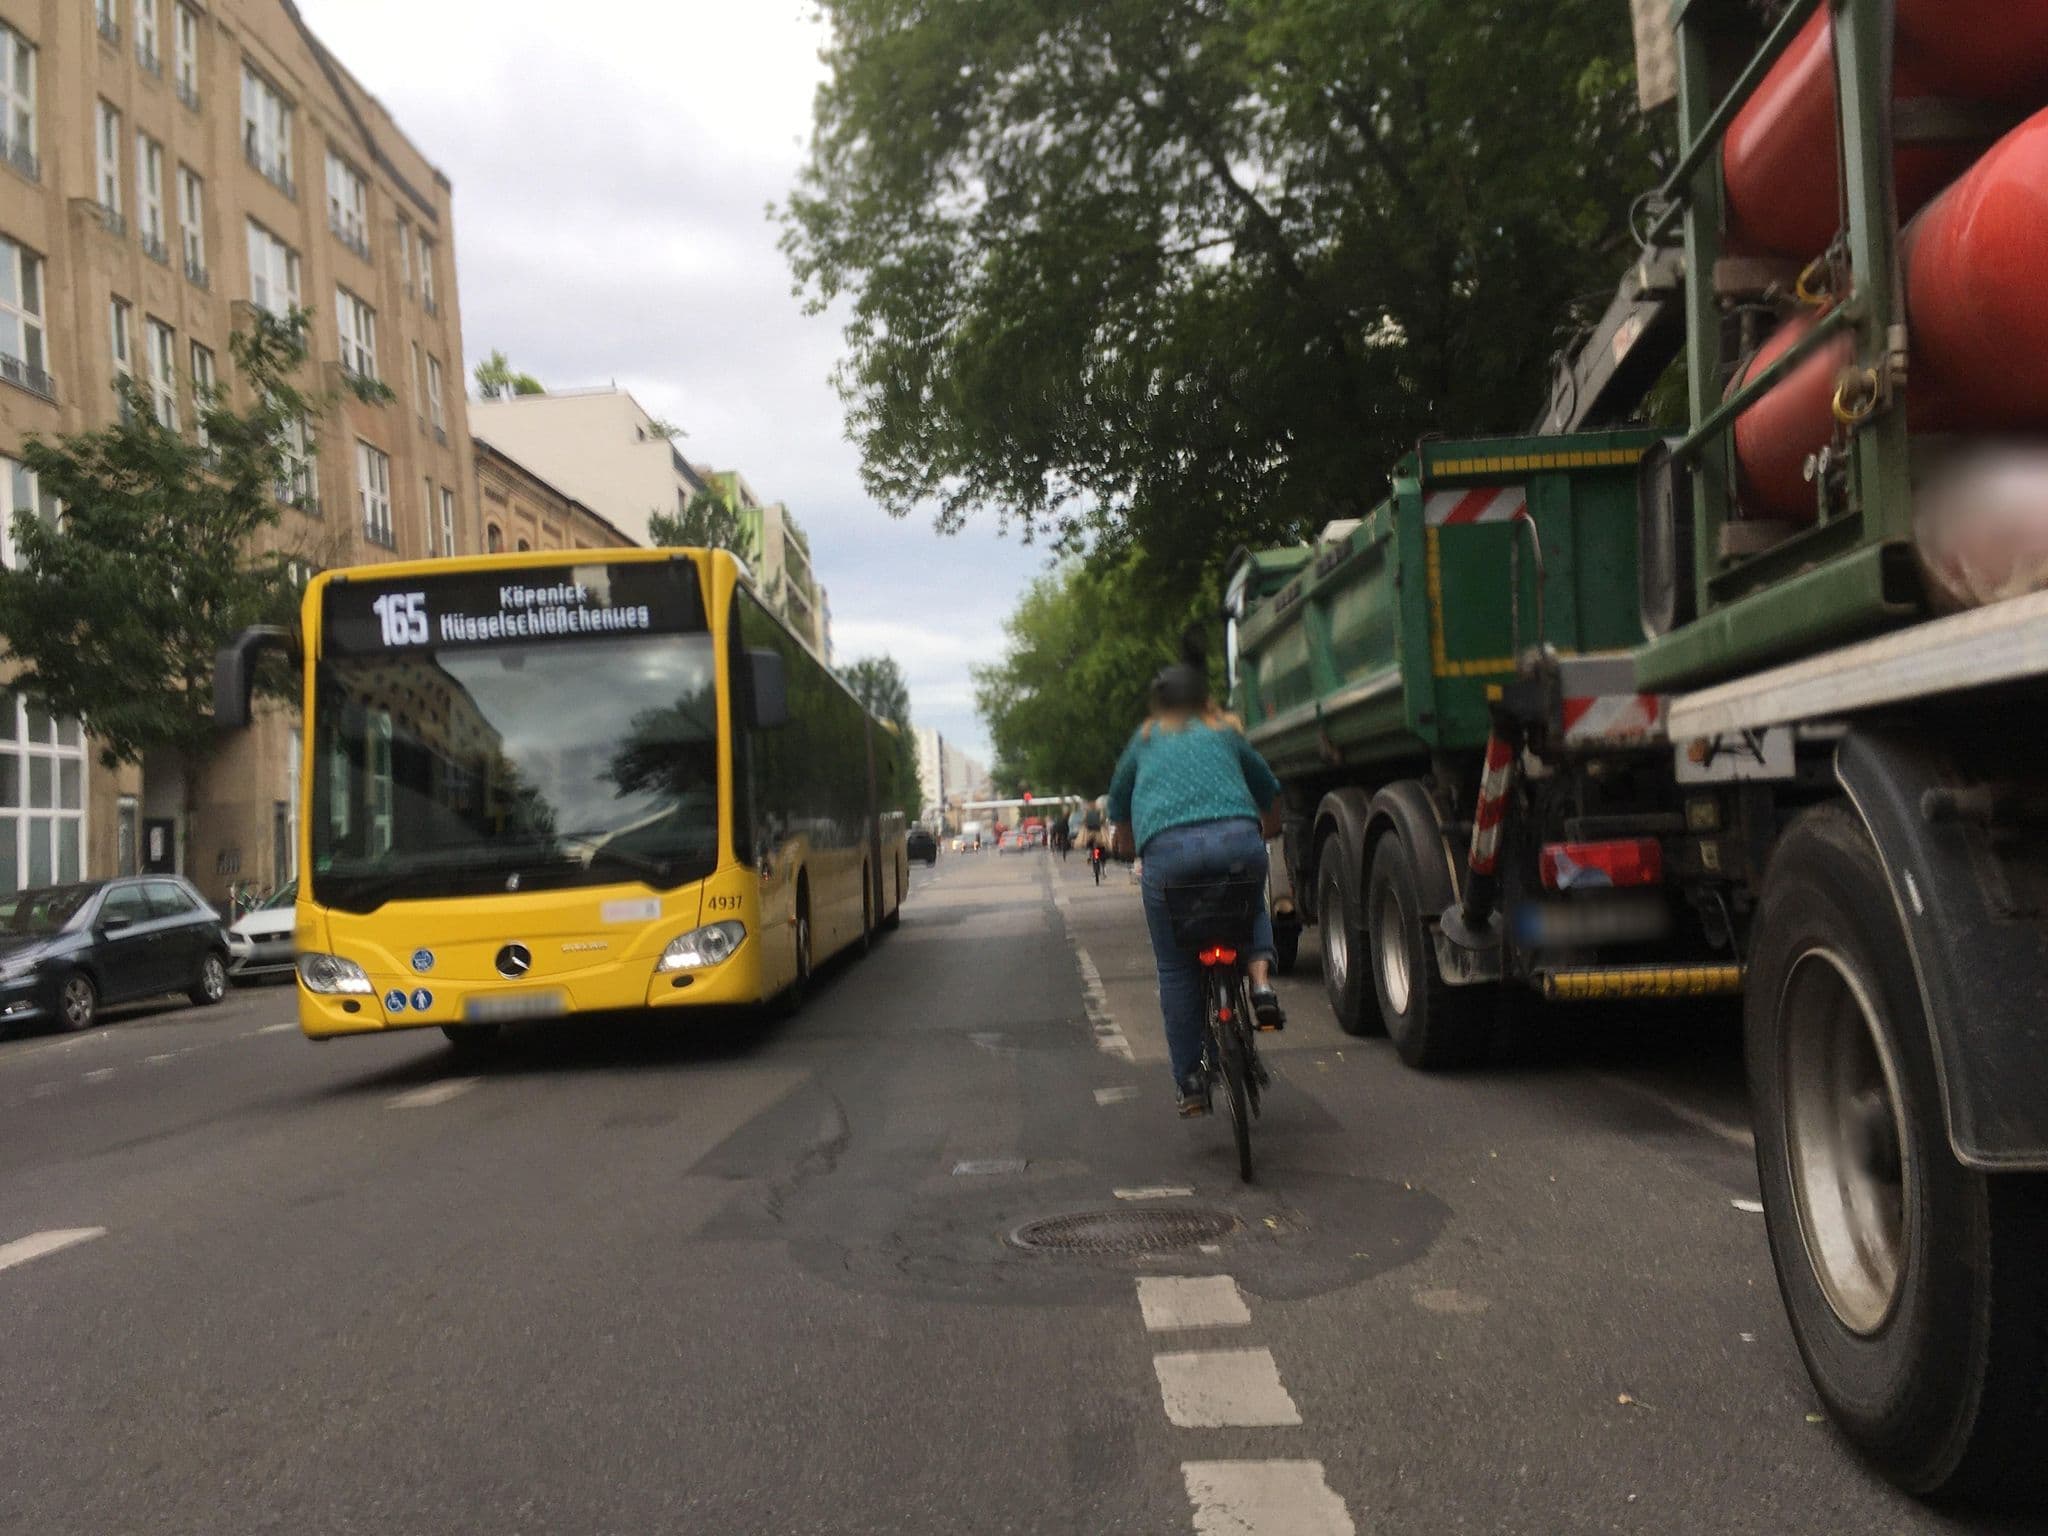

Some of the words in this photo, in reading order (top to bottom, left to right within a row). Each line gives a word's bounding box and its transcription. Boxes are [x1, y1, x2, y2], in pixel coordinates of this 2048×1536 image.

[500, 583, 587, 608] Köpenick
[373, 592, 429, 646] 165
[708, 895, 742, 911] 4937
